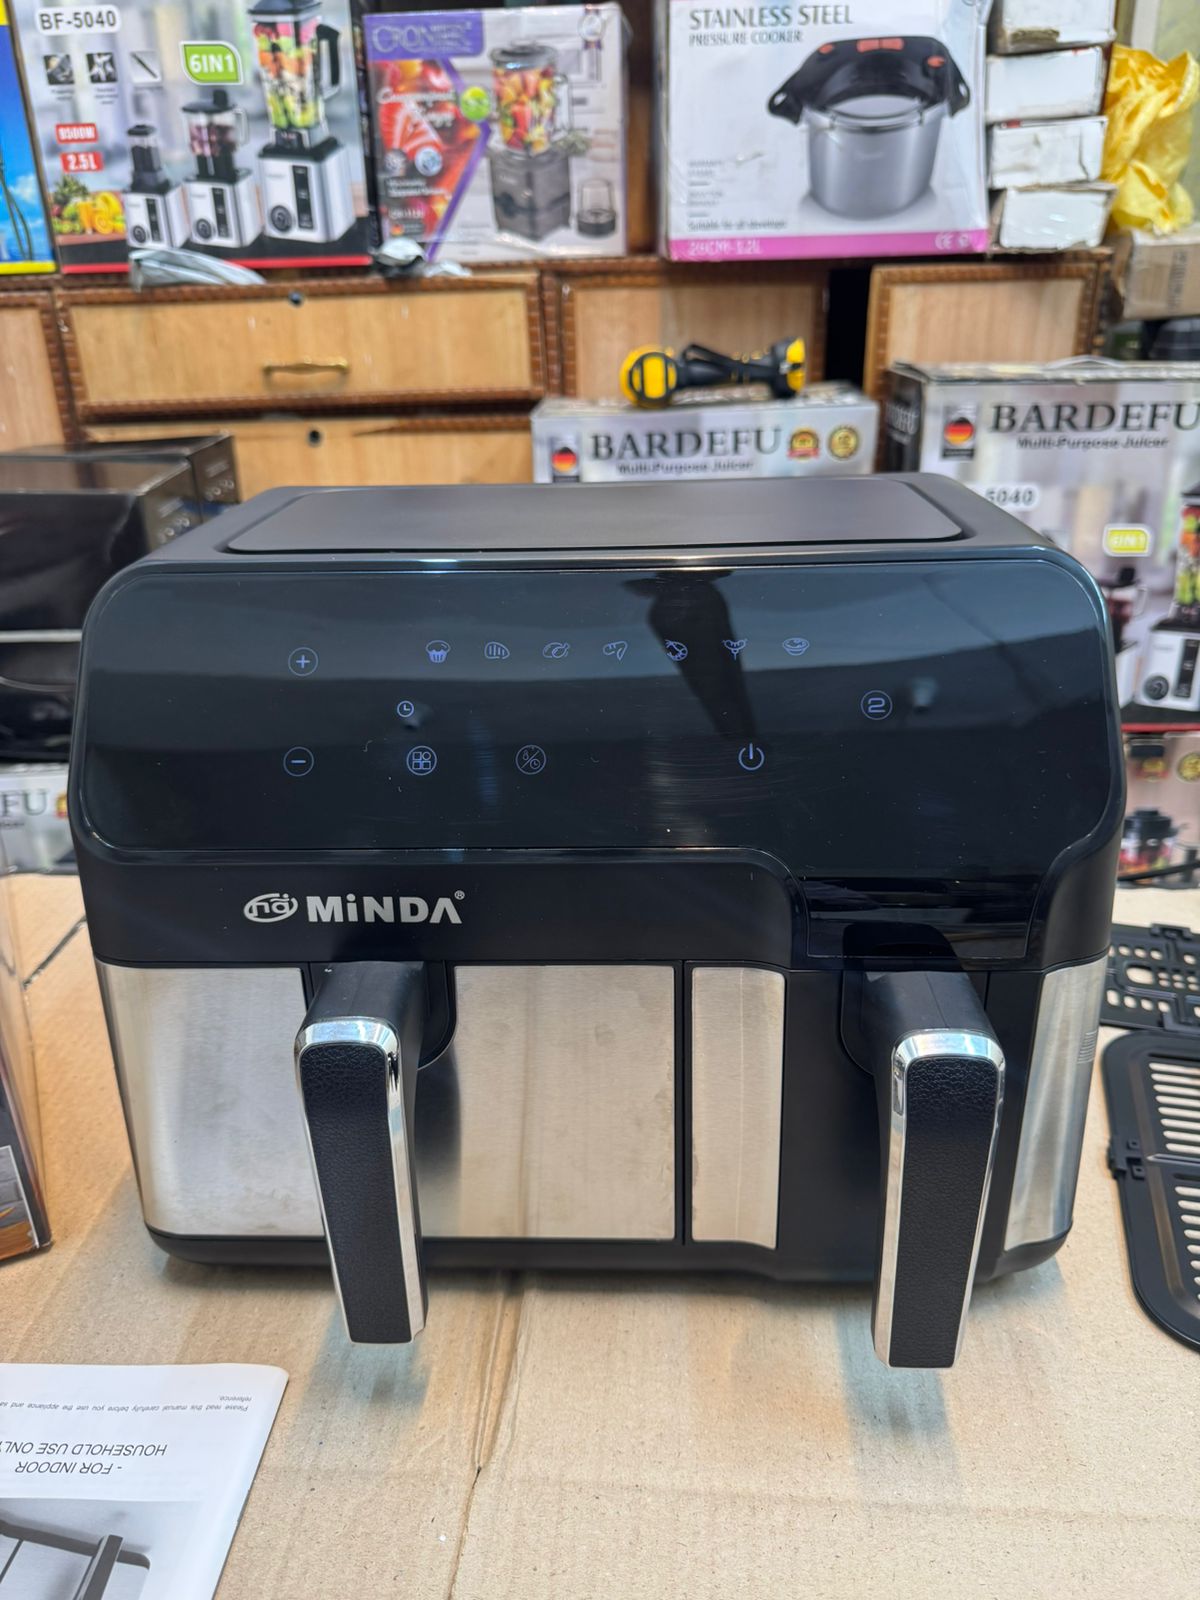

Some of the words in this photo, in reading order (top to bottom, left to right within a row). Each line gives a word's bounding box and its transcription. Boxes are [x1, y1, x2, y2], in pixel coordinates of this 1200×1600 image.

[38, 10, 117, 31] BF-5040
[689, 6, 793, 31] STAINLESS
[797, 4, 854, 26] STEEL
[688, 32, 747, 47] PRESSURE
[750, 30, 804, 45] COOKER
[67, 153, 99, 170] 2.5L
[990, 401, 1200, 434] BARDEFU
[592, 424, 783, 461] BARDEFU
[1017, 435, 1119, 452] Multi-Purpose
[1122, 437, 1170, 450] Juicer
[617, 459, 708, 476] Multi-Purpose
[712, 457, 754, 473] Juicer
[10, 1401, 25, 1409] and
[27, 1402, 60, 1411] appliance
[91, 1404, 106, 1412] you
[107, 1405, 130, 1413] before
[131, 1404, 160, 1413] carefully
[161, 1404, 188, 1412] manual
[224, 1404, 249, 1412] Please
[36, 1442, 69, 1455] USE
[71, 1442, 168, 1457] HOUSEHOLD
[15, 1460, 77, 1474] INDOOR
[79, 1462, 114, 1475] FOR
